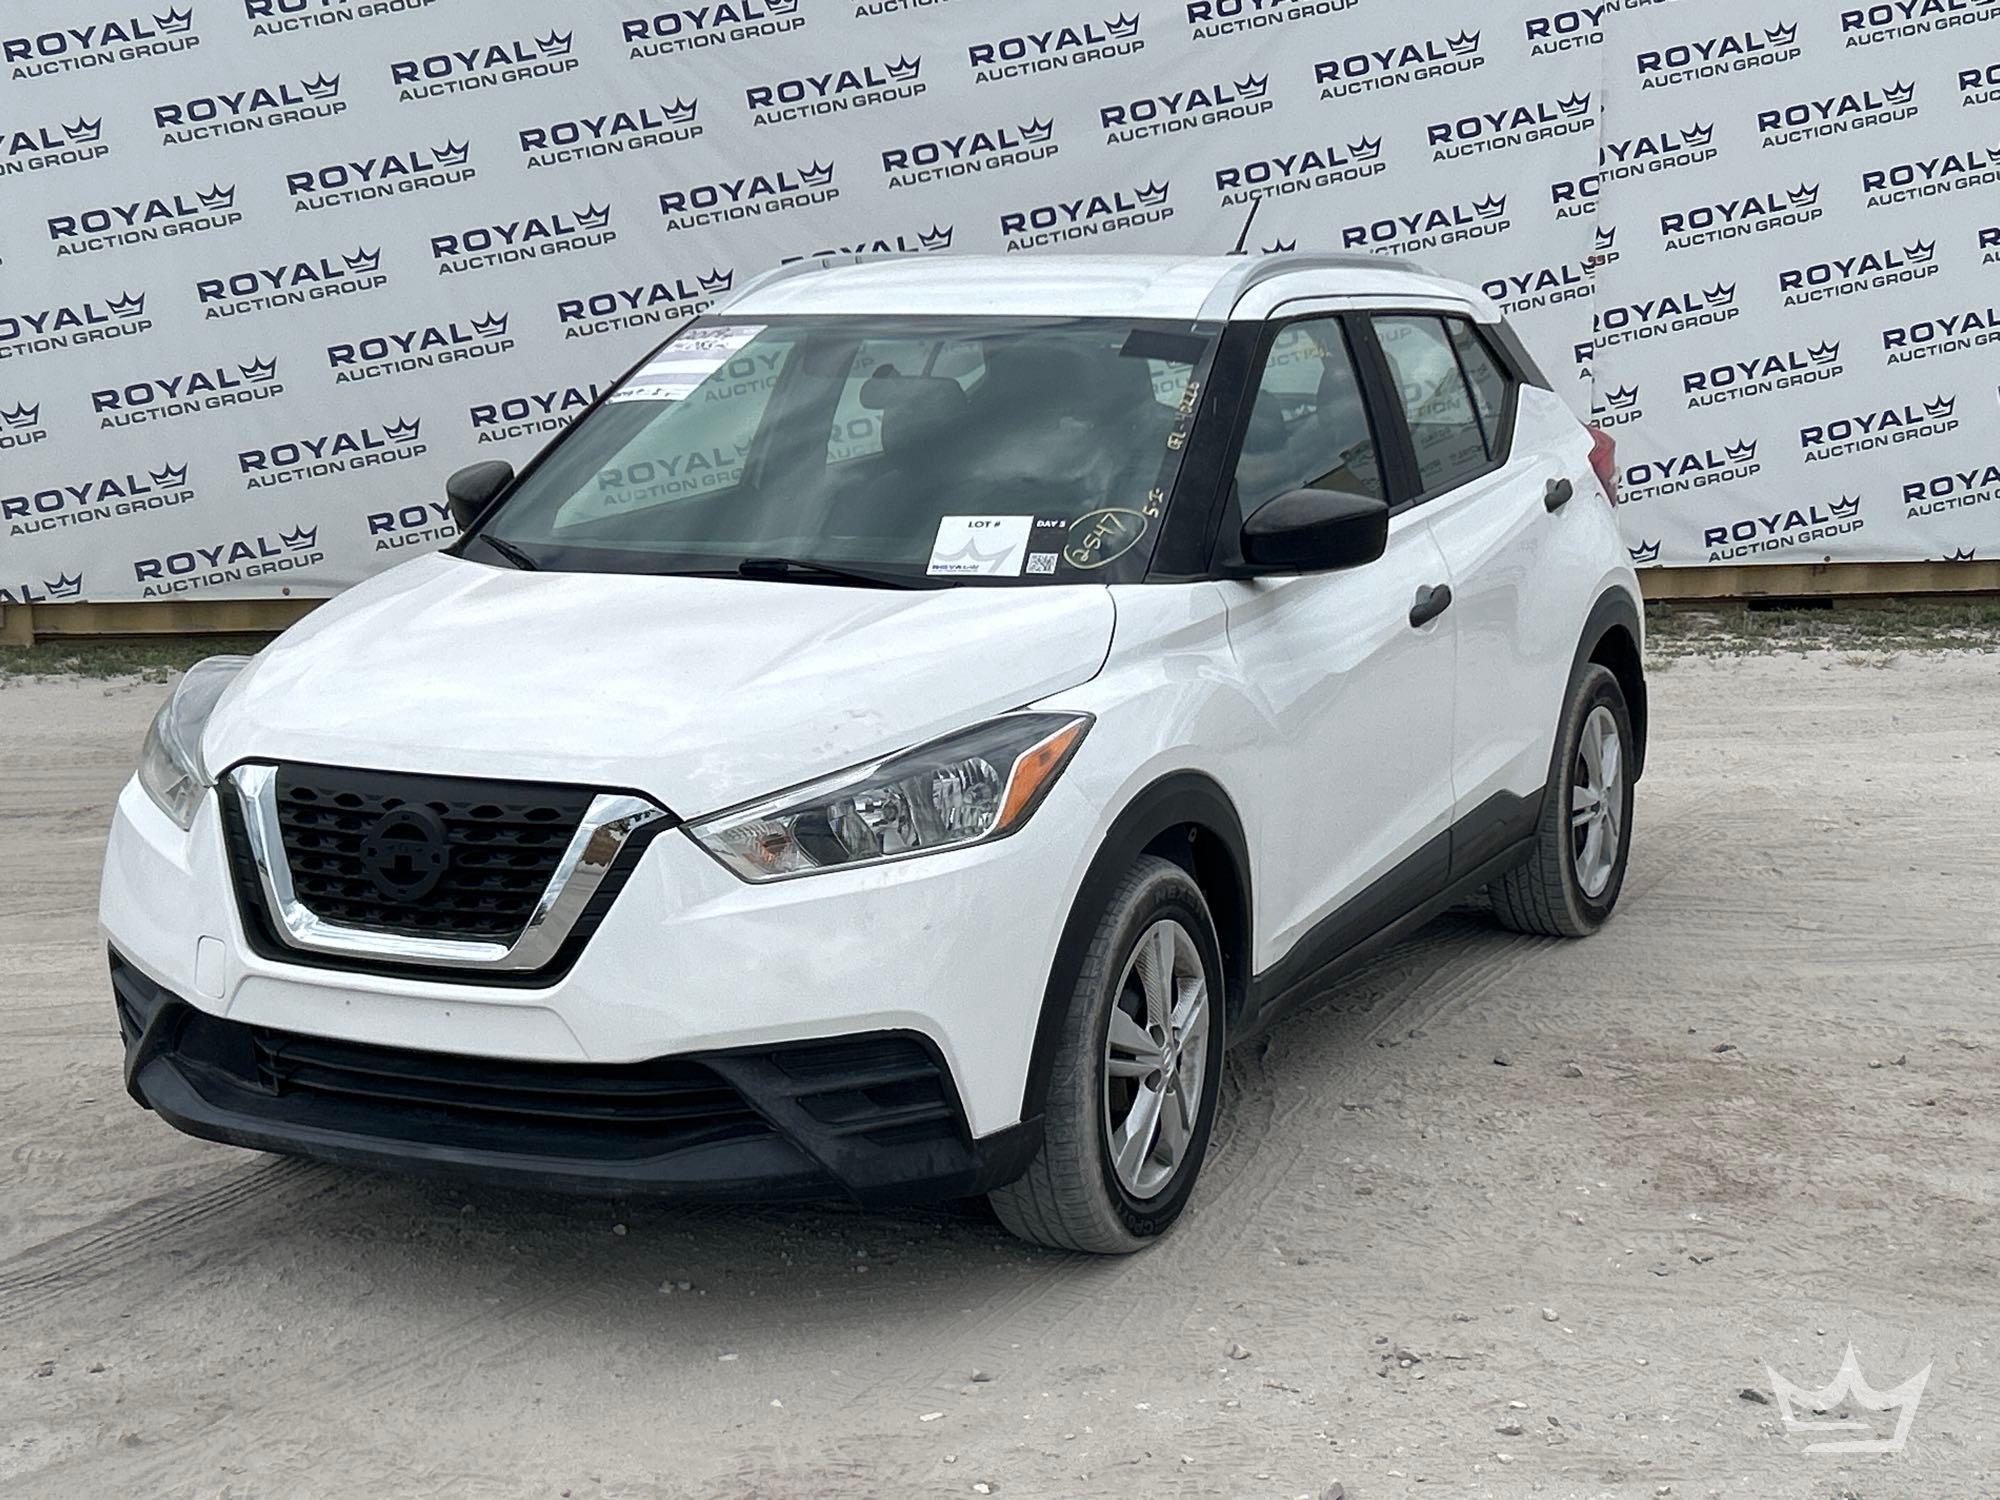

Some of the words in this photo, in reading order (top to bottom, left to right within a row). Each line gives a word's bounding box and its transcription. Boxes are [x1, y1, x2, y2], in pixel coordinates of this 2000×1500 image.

[2, 18, 156, 62] ROYAL
[253, 8, 353, 37] AUCTION
[622, 0, 765, 42] ROYAL
[630, 32, 726, 59] AUCTION
[730, 17, 805, 41] GROUP
[1193, 11, 1283, 40] AUCTION
[1287, 0, 1358, 20] GROUP
[1846, 21, 1931, 48] AUCTION
[1935, 7, 2000, 30] GROUP
[12, 51, 115, 80] AUCTION
[119, 36, 199, 60] GROUP
[391, 41, 537, 85] ROYAL
[969, 24, 1106, 67] ROYAL
[976, 55, 1068, 84] AUCTION
[1072, 40, 1144, 64] GROUP
[1314, 41, 1447, 84] ROYAL
[1531, 32, 1603, 56] AUCTIO
[1637, 32, 1765, 74] ROYAL
[400, 73, 497, 102] AUCTION
[502, 59, 579, 82] GROUP
[746, 67, 887, 109] ROYAL
[1320, 72, 1410, 100] AUCTION
[1414, 57, 1484, 80] GROUP
[1642, 62, 1729, 90] AUCTION
[1733, 48, 1801, 71] GROUP
[154, 84, 304, 128] ROYAL
[163, 116, 264, 146] AUCTION
[268, 102, 347, 126] GROUP
[754, 98, 848, 126] AUCTION
[852, 83, 926, 107] GROUP
[1100, 85, 1235, 128] ROYAL
[1107, 116, 1197, 145] AUCTION
[1202, 101, 1273, 125] GROUP
[1427, 103, 1558, 146] ROYAL
[1758, 91, 1883, 132] ROYAL
[519, 109, 662, 152] ROYAL
[527, 140, 623, 169] AUCTION
[628, 126, 703, 149] GROUP
[1433, 133, 1521, 162] AUCTION
[1526, 118, 1594, 142] GROUP
[1762, 121, 1847, 148] AUCTION
[1851, 107, 1918, 129] GROUP
[28, 145, 109, 170] GROUP
[882, 129, 1019, 172] ROYAL
[889, 160, 981, 189] AUCTION
[986, 145, 1058, 169] GROUP
[1216, 147, 1348, 190] ROYAL
[1599, 133, 1681, 167] YAL
[1649, 148, 1717, 172] GROUP
[1863, 151, 1986, 192] ROYAL
[286, 152, 433, 195] ROYAL
[295, 184, 394, 212] AUCTION
[398, 169, 475, 192] GROUP
[659, 172, 799, 215] ROYAL
[1221, 178, 1311, 208] AUCTION
[1315, 162, 1386, 186] GROUP
[1867, 181, 1951, 208] AUCTION
[1955, 171, 2000, 189] GRO
[48, 196, 199, 240] ROYAL
[667, 203, 761, 232] AUCTION
[765, 189, 839, 212] GROUP
[1001, 192, 1135, 236] ROYAL
[1007, 223, 1098, 253] AUCTION
[1102, 208, 1173, 232] GROUP
[1342, 205, 1473, 249] ROYAL
[1441, 220, 1510, 244] GROUP
[1661, 193, 1787, 235] ROYAL
[1665, 223, 1751, 251] AUCTION
[1755, 209, 1822, 231] GROUP
[57, 228, 158, 257] AUCTION
[162, 213, 242, 237] GROUP
[431, 215, 575, 258] ROYAL
[439, 246, 536, 275] AUCTION
[540, 231, 616, 255] GROUP
[197, 259, 345, 303] ROYAL
[1779, 250, 1904, 292] ROYAL
[1784, 280, 1868, 307] AUCTION
[1872, 265, 1938, 287] GROUP
[206, 291, 305, 320] AUCTION
[309, 275, 387, 299] GROUP
[557, 280, 699, 323] ROYAL
[72, 320, 152, 344] GROUP
[565, 310, 660, 339] AUCTION
[665, 300, 715, 320] GRO
[1671, 308, 1739, 331] GROUP
[327, 323, 473, 367] ROYAL
[336, 355, 434, 384] AUCTION
[438, 340, 514, 363] GROUP
[1887, 338, 1971, 365] AUCTION
[91, 368, 241, 413] ROYAL
[1683, 351, 1808, 394] ROYAL
[1688, 381, 1772, 409] AUCTION
[1776, 366, 1843, 389] GROUP
[101, 400, 200, 429] AUCTION
[205, 384, 284, 409] GROUP
[1800, 406, 1924, 448] ROYAL
[238, 429, 385, 473] ROYAL
[478, 415, 574, 444] AUCTION
[1805, 435, 1888, 463] AUCTION
[1892, 420, 1958, 443] GROUP
[247, 460, 345, 489] AUCTION
[349, 445, 427, 469] GROUP
[600, 448, 735, 491] ROYAL
[1618, 450, 1725, 488] OYAL
[1693, 464, 1760, 487] GROUP
[2, 475, 151, 520] ROYAL
[10, 506, 111, 536] AUCTION
[115, 491, 194, 515] GROUP
[603, 478, 698, 506] AUCTION
[1907, 491, 1990, 519] AUCTION
[376, 525, 461, 551] AUCTIO
[1036, 520, 1059, 528] DAY
[1072, 512, 1127, 562] 2547
[1704, 506, 1829, 548] ROYAL
[1709, 535, 1794, 563] AUCTION
[1798, 519, 1863, 543] GROUP
[134, 537, 281, 582] ROYAL
[143, 568, 241, 598] AUCTION
[246, 552, 324, 577] GROUP
